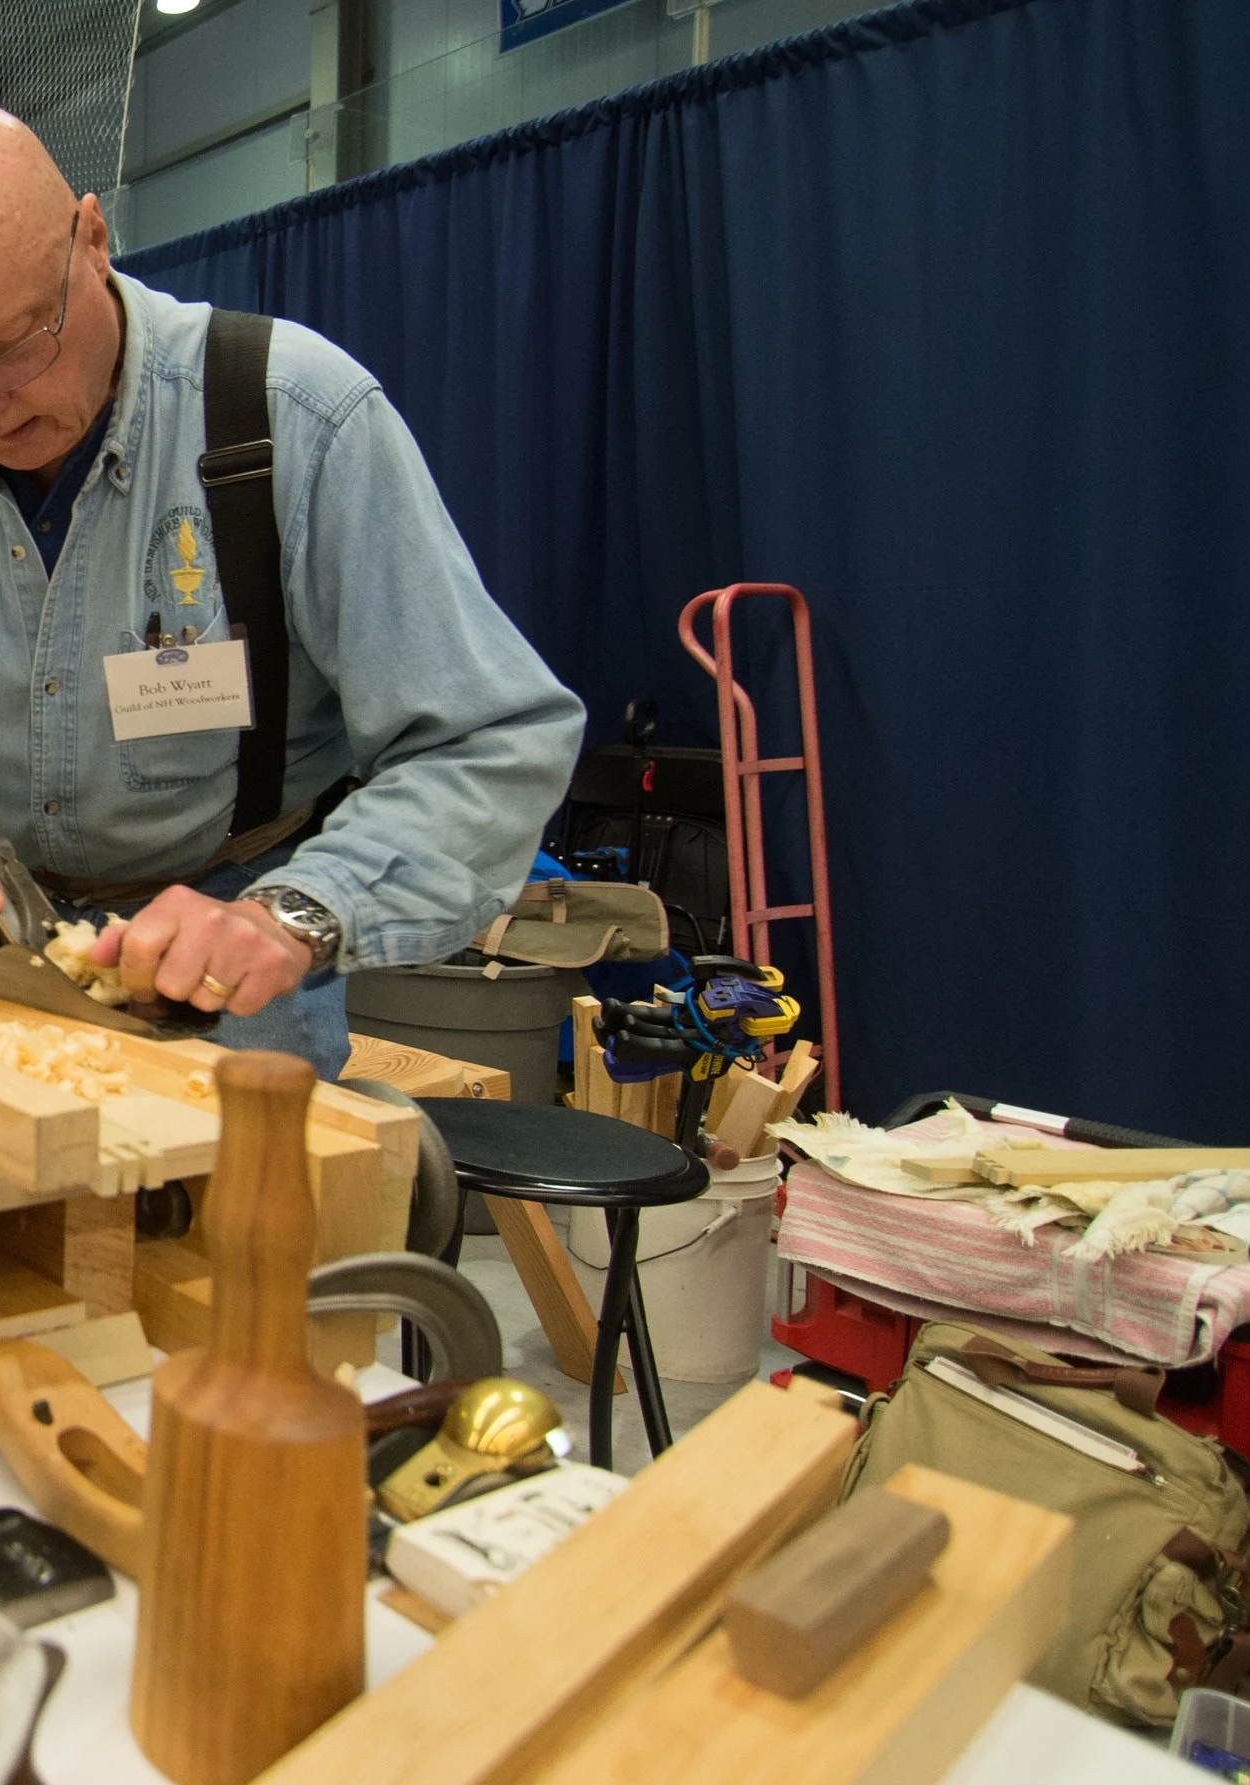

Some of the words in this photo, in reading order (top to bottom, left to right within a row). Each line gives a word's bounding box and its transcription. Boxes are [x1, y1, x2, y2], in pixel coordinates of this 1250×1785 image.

[168, 505, 202, 518] GUILD
[138, 682, 167, 696] Bob
[170, 679, 213, 694] Wyatt
[114, 702, 142, 714] Guild
[144, 699, 154, 711] of
[155, 698, 174, 709] NH
[175, 692, 240, 706] Woodworkers
